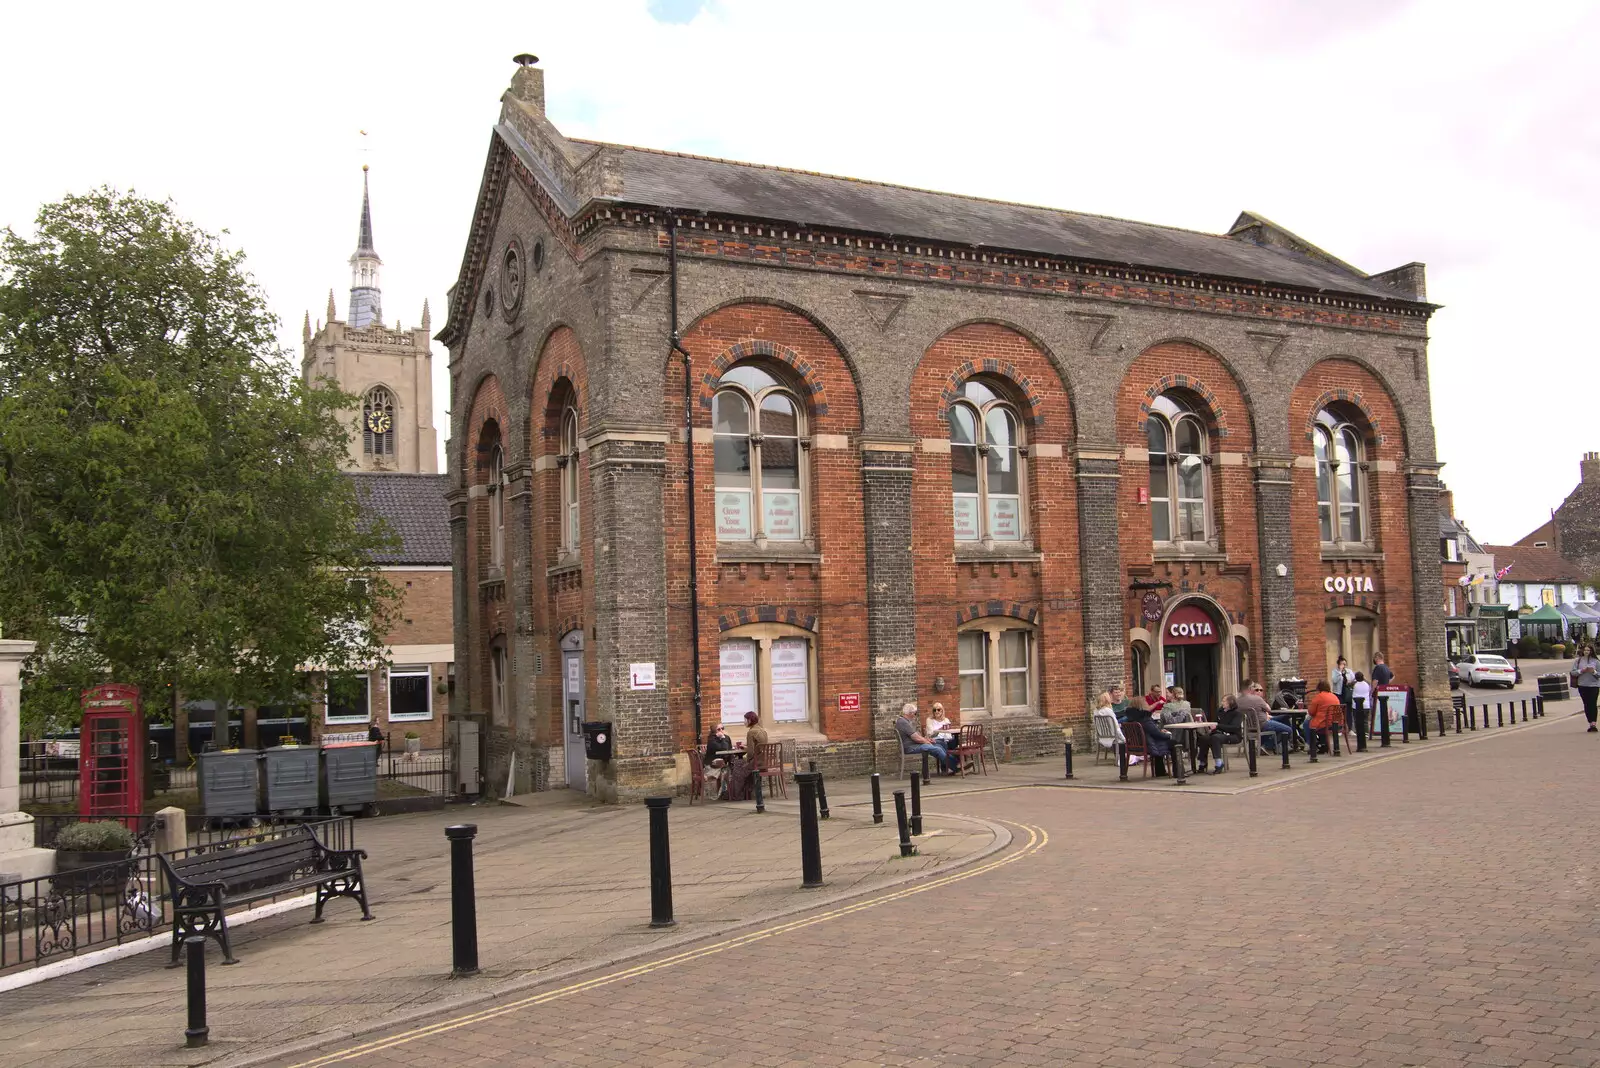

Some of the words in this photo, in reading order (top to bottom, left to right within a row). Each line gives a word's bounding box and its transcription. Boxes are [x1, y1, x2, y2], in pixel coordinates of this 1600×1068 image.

[1323, 576, 1374, 595] COSTA
[1143, 594, 1158, 603] COSTA
[1144, 609, 1161, 620] COFFEE
[1170, 622, 1212, 638] COSTA
